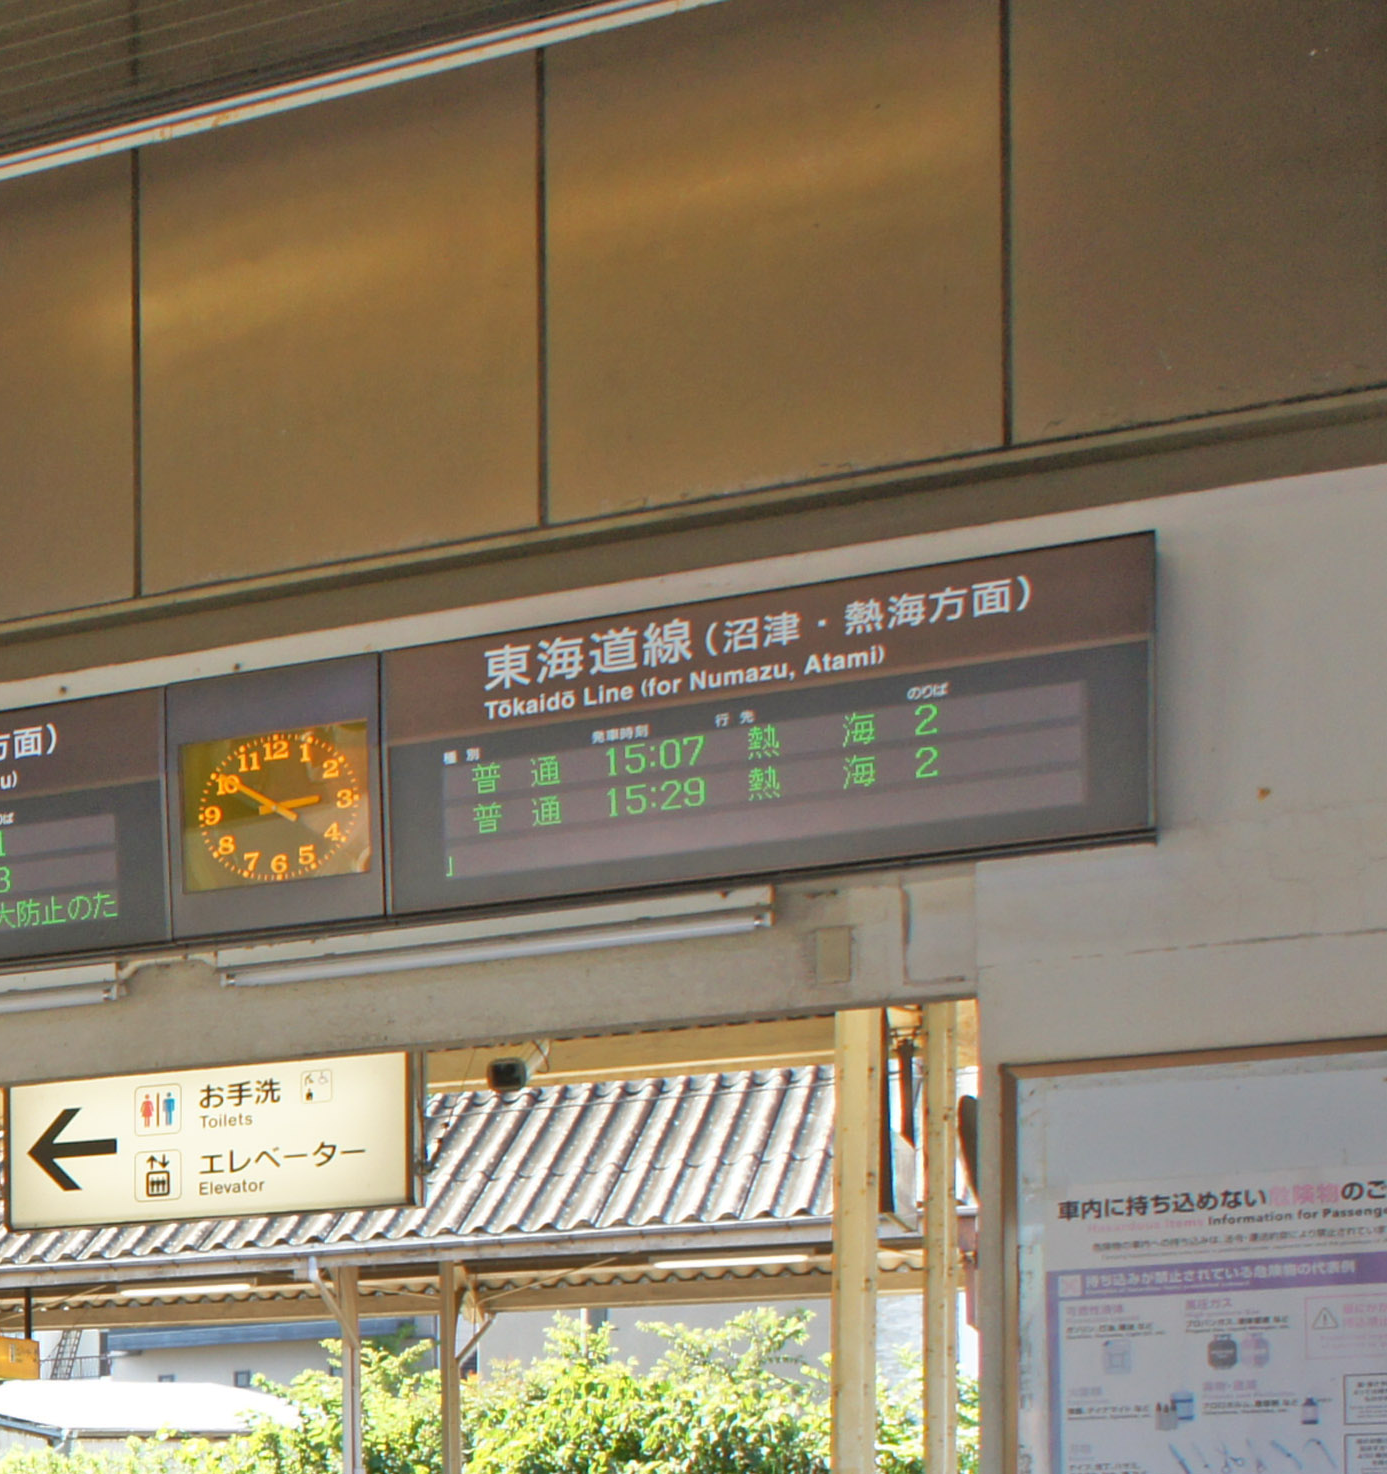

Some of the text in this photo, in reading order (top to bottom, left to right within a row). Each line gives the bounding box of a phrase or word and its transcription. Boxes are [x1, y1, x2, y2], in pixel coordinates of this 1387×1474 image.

[482, 574, 1034, 693] 東海道線（沼津・熱海方面）
[484, 643, 887, 721] Tōkaidō Line (for Numazu, Atami)
[907, 681, 949, 700] のりば
[263, 740, 290, 761] 12
[604, 734, 705, 777] 15:07
[914, 703, 939, 737] 2
[238, 752, 261, 772] 11
[299, 743, 311, 763] 1
[322, 758, 340, 779] 2
[216, 774, 241, 796] 10
[605, 776, 706, 819] 15:29
[914, 745, 939, 780] 2
[336, 788, 354, 809] 3
[204, 805, 222, 826] 9
[324, 822, 342, 842] 4
[218, 835, 236, 855] 8
[299, 844, 317, 865] 5
[243, 852, 260, 872] 7
[270, 853, 289, 874] 6
[199, 1078, 282, 1109] お手洗
[199, 1112, 254, 1130] Toilets
[199, 1140, 366, 1175] エレベーター
[199, 1178, 265, 1196] Elevator
[1207, 1209, 1293, 1227] Information
[1297, 1208, 1319, 1220] for
